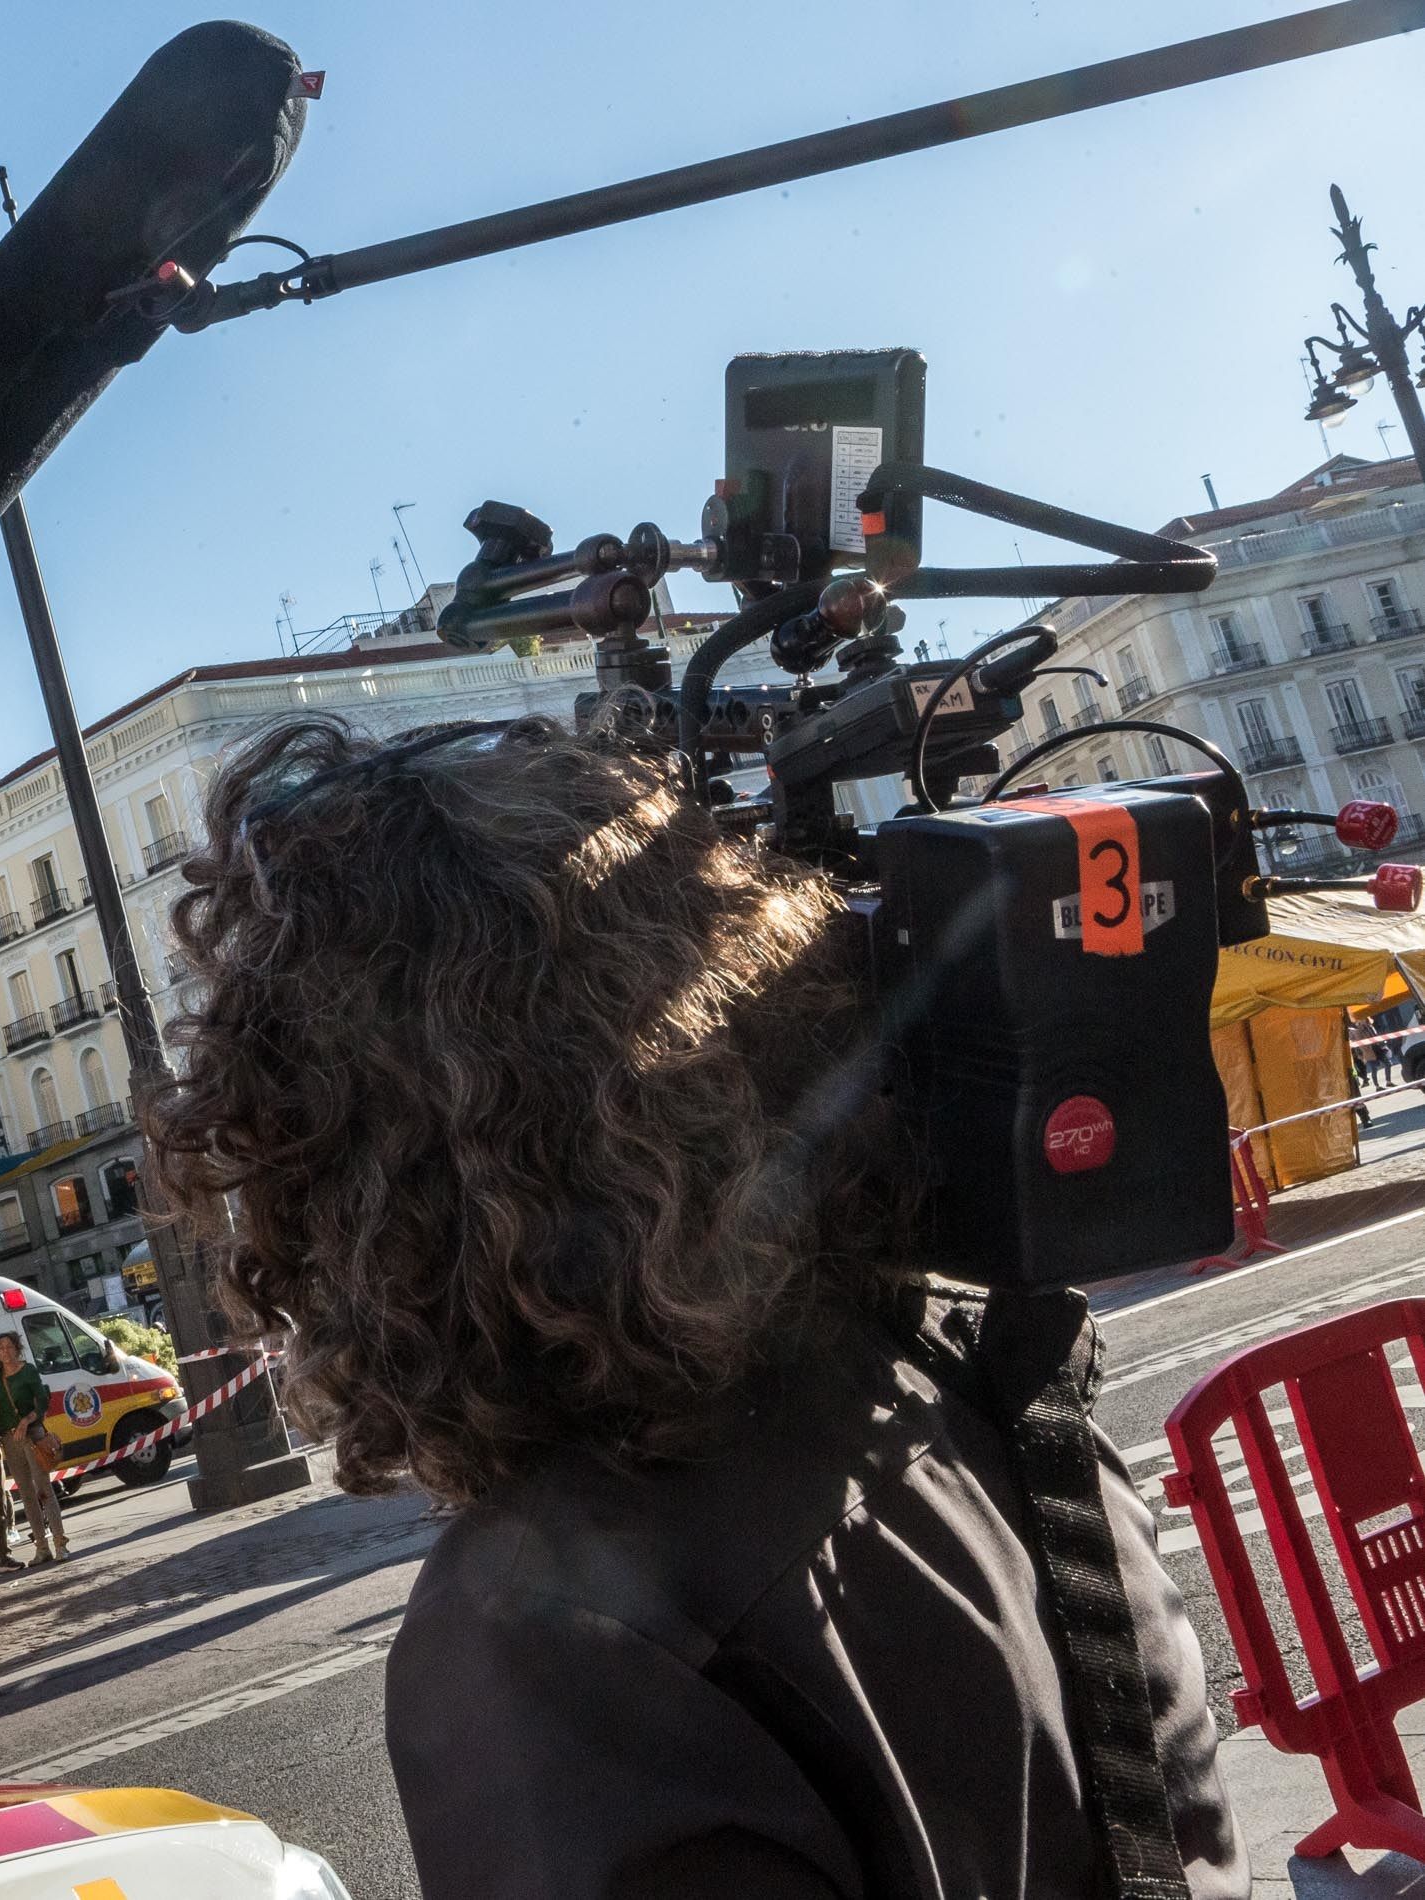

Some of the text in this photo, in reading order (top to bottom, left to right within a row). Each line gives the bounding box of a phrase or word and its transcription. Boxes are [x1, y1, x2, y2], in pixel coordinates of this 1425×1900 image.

[915, 684, 930, 695] RX
[939, 692, 964, 708] AM
[1089, 839, 1130, 928] 3
